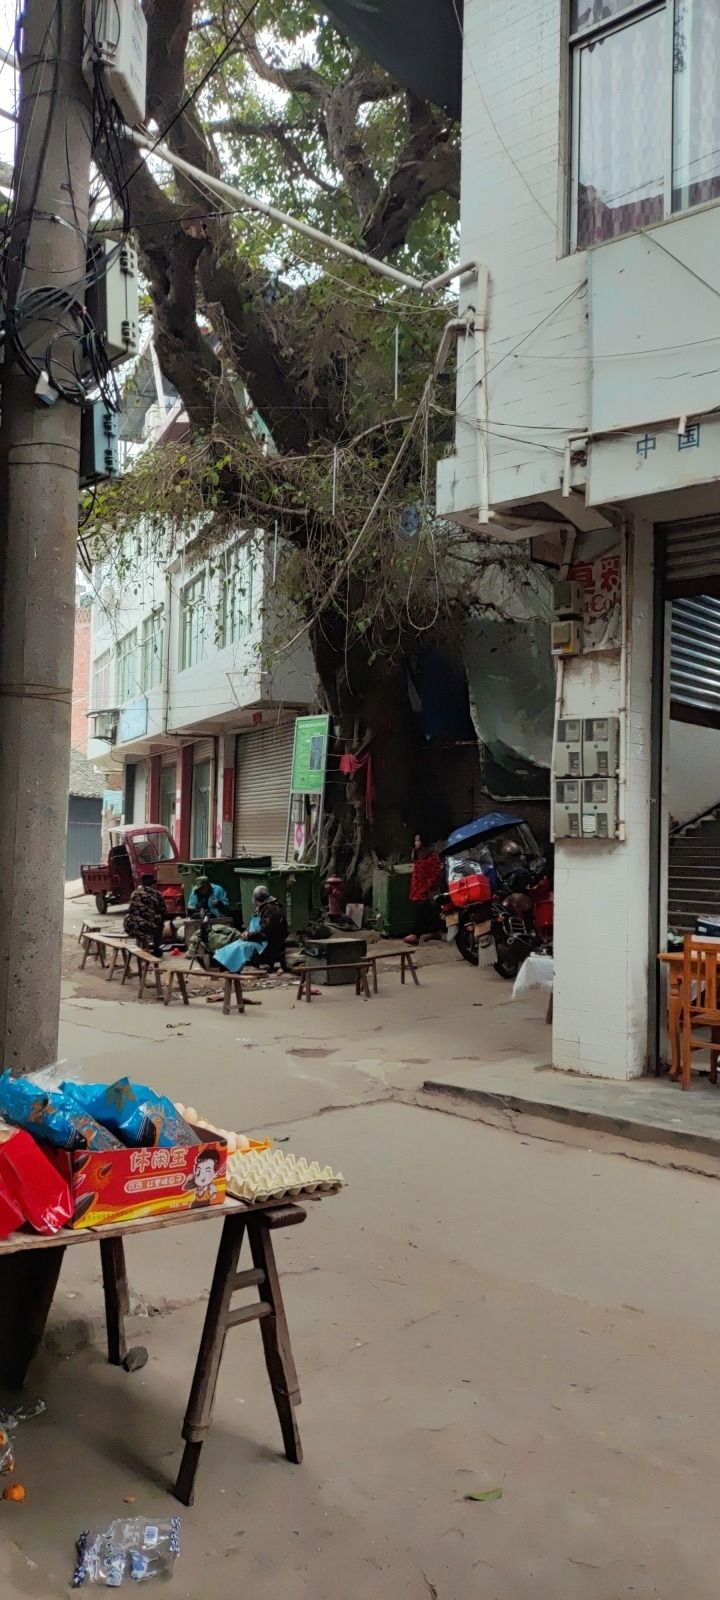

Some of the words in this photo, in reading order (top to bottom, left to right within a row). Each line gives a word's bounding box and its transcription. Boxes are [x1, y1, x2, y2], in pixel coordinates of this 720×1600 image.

[636, 423, 700, 460] 中国
[130, 1146, 188, 1173] 休闲王
